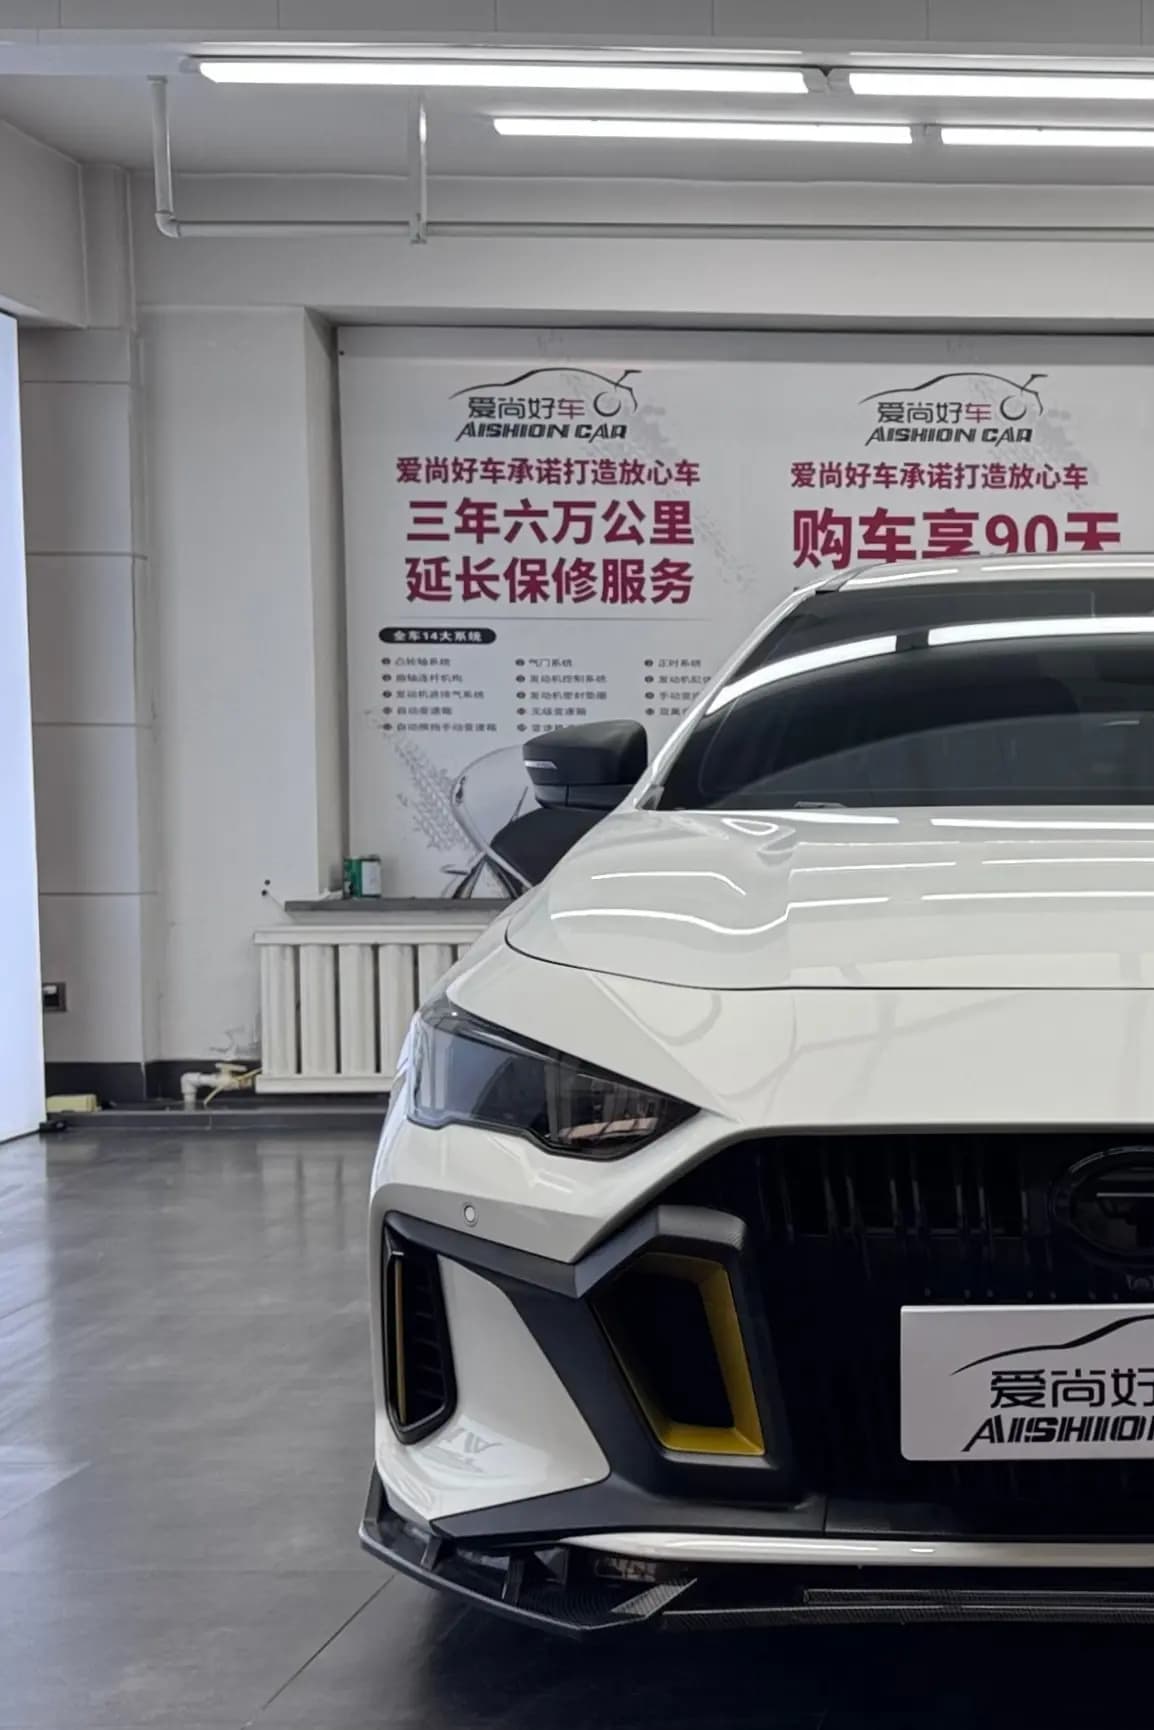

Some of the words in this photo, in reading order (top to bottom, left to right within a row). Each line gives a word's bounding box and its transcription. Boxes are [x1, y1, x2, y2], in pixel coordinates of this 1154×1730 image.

[468, 397, 585, 420] 爱尚好车
[877, 401, 992, 424] 爱尚好车
[455, 422, 571, 442] AISHION
[574, 423, 628, 443] CAR
[865, 427, 976, 447] AISHION
[981, 427, 1033, 447] CAR
[396, 456, 701, 487] 爱尚好车承诺打造放心车
[790, 461, 1089, 490] 爱尚好车承诺打造放心车
[406, 497, 695, 546] 三年六万公里
[793, 506, 1121, 570] 购车享90天
[405, 556, 694, 605] 延长保修服务
[393, 630, 482, 642] 全车14大系统
